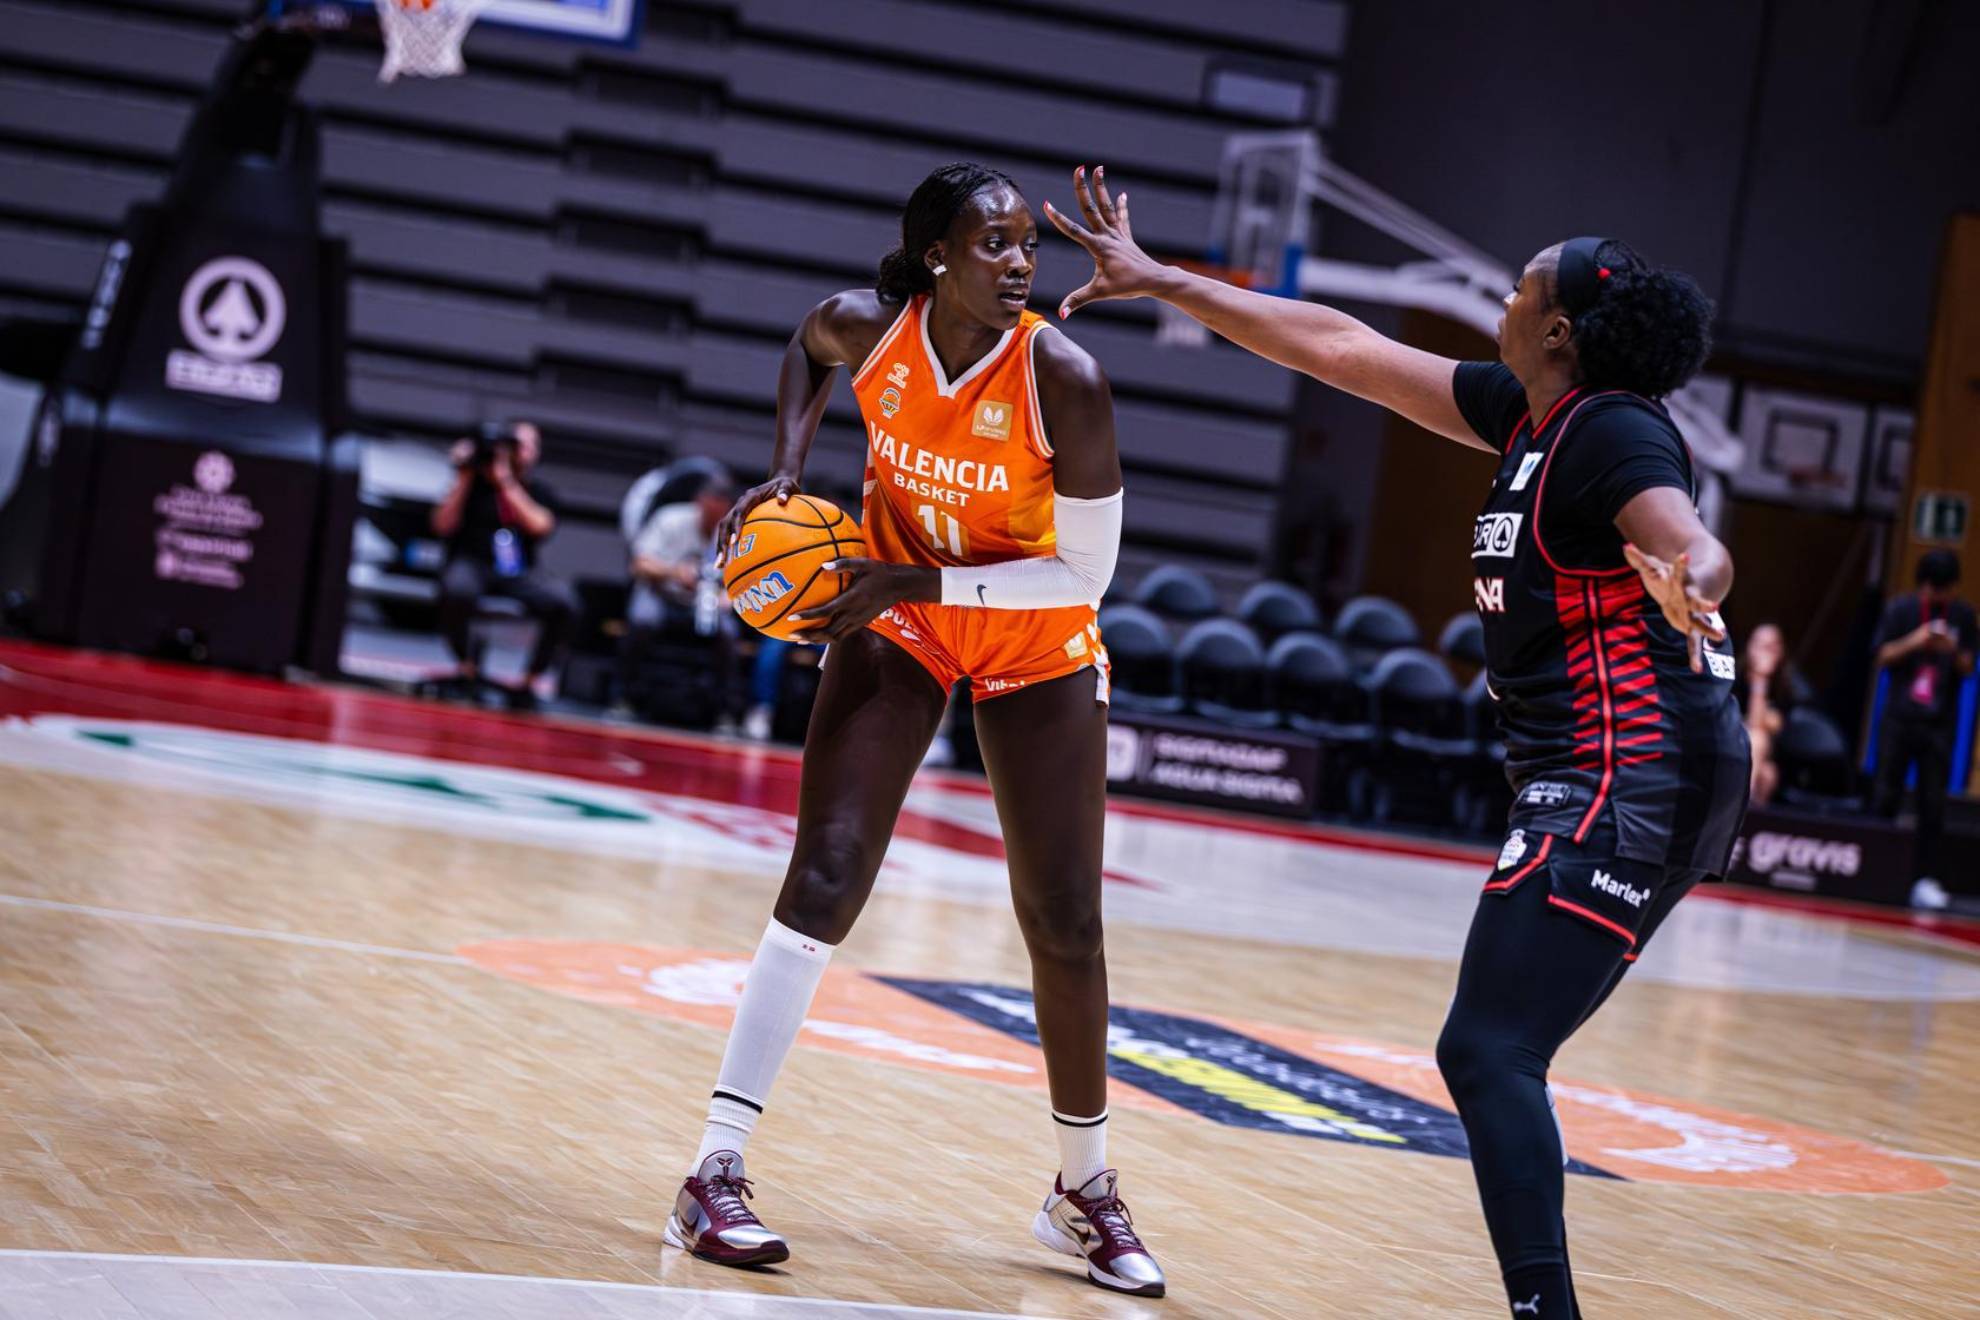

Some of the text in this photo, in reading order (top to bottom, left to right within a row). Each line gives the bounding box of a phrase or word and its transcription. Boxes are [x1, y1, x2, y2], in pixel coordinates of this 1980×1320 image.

[870, 420, 1009, 492] VALENCIA
[893, 472, 970, 507] BASKET
[917, 504, 963, 557] 11
